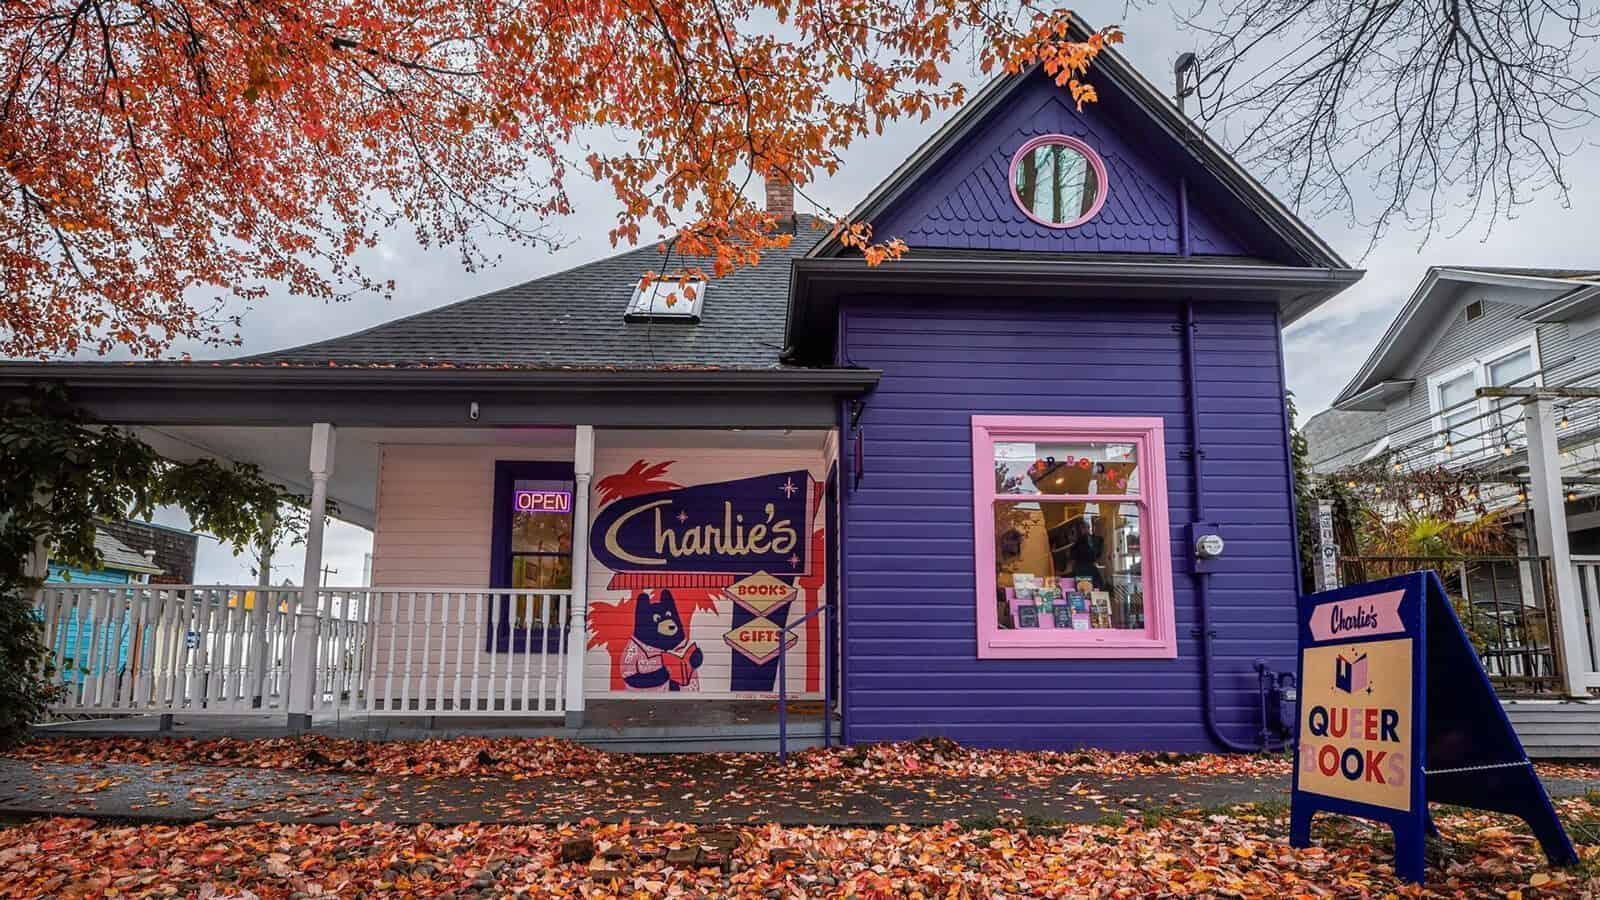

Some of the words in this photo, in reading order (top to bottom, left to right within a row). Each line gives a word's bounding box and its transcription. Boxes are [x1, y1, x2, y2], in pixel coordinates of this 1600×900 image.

[518, 493, 567, 510] OPEN
[604, 499, 797, 565] Charlie's
[738, 584, 787, 596] BOOKS
[1330, 604, 1378, 634] Charlie's
[739, 630, 784, 642] GIFTS
[1309, 705, 1400, 743] QUEER
[1301, 744, 1406, 787] BOOKS
